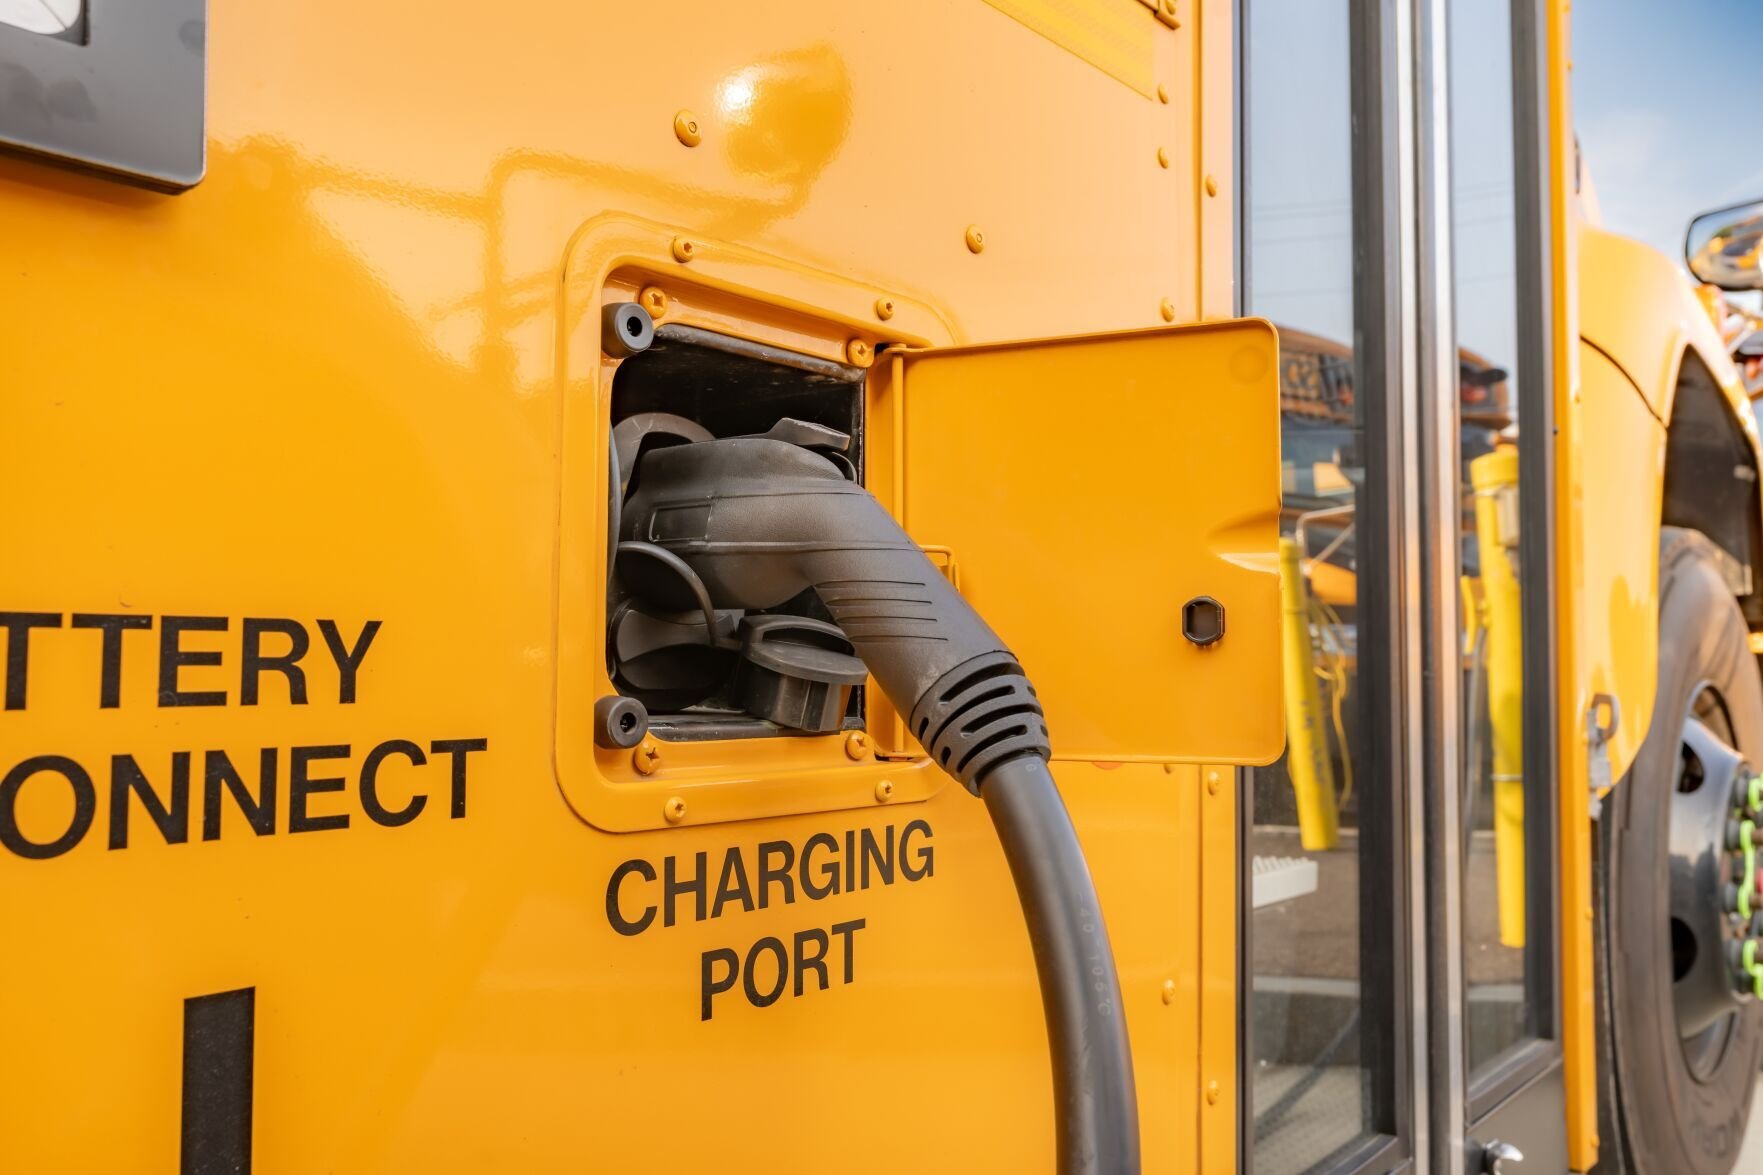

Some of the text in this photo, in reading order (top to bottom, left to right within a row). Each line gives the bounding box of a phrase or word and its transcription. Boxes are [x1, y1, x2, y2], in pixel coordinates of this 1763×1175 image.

[0, 611, 383, 711] TTERY
[0, 737, 488, 860] ONNECT
[605, 819, 935, 937] CHARGING
[701, 918, 866, 1022] PORT
